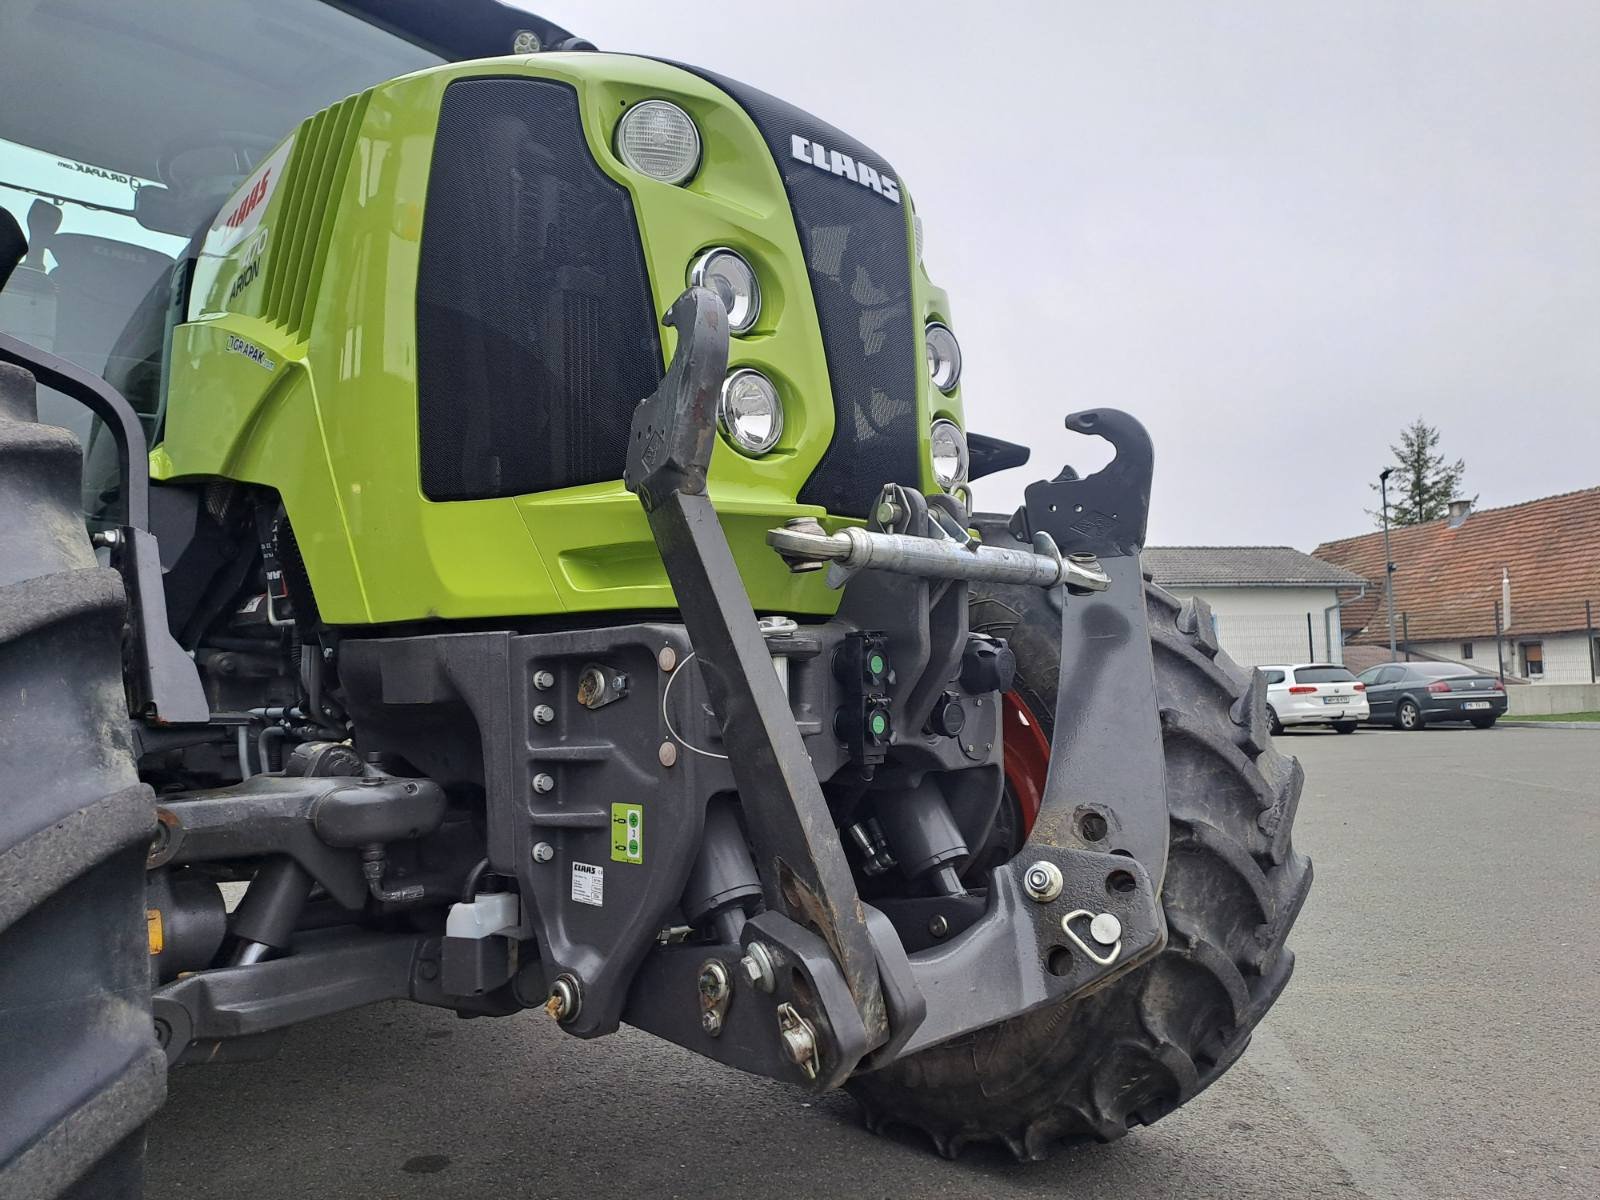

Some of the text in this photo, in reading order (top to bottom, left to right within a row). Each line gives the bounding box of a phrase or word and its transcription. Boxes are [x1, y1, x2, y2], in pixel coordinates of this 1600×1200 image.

[791, 134, 900, 204] CLAAS
[229, 256, 260, 302] ARION
[574, 863, 596, 874] CLAAS
